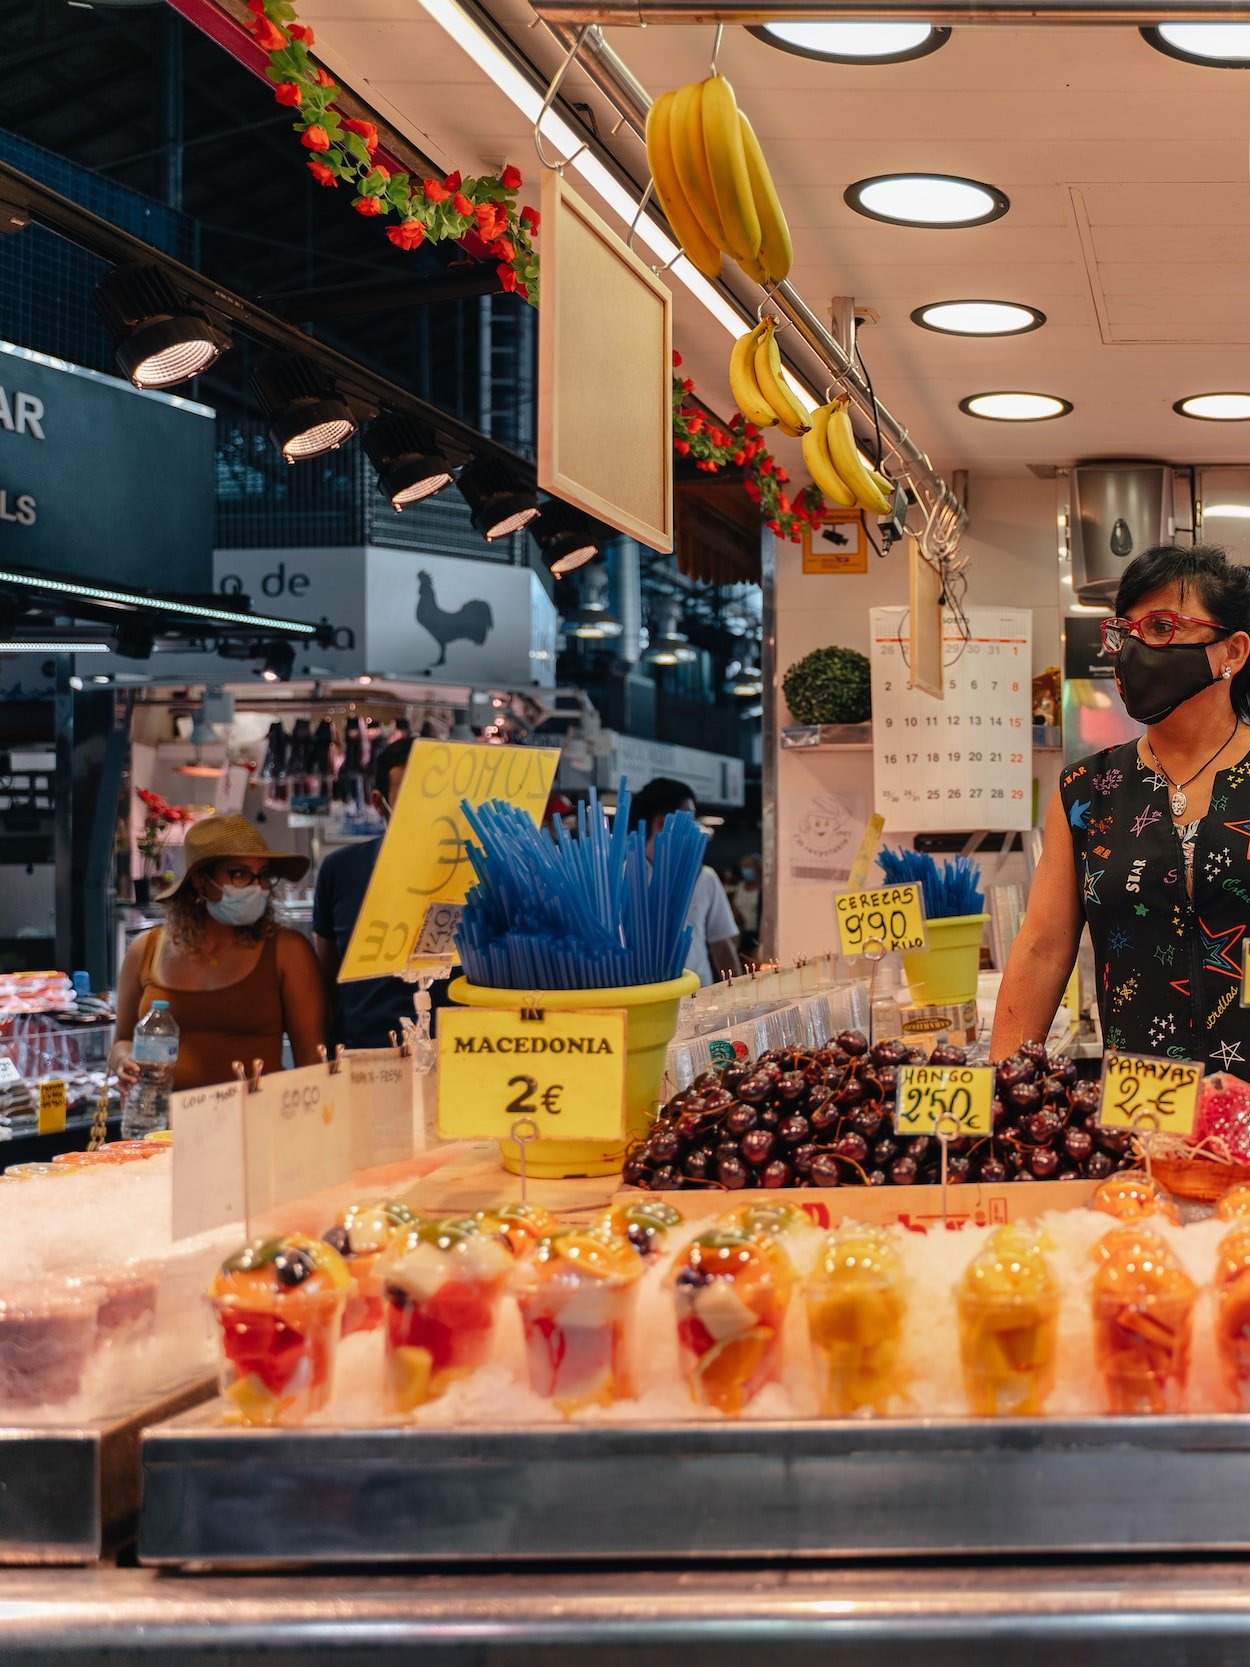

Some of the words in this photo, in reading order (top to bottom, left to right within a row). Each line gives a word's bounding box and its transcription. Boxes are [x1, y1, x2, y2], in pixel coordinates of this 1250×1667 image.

[262, 562, 311, 598] de
[988, 645, 1000, 655] 31
[1013, 646, 1018, 655] 1
[885, 682, 892, 691] 2
[950, 680, 956, 689] 5
[971, 680, 978, 689] 6
[992, 681, 998, 690] 7
[1012, 682, 1019, 691] 8
[886, 718, 893, 728] 9
[904, 717, 918, 727] 10
[926, 716, 938, 726] 11
[947, 716, 960, 725] 12
[969, 716, 982, 725] 13
[990, 717, 1002, 726] 14
[1009, 718, 1021, 727] 15
[884, 755, 897, 764] 16
[906, 754, 918, 763] 17
[927, 753, 939, 762] 18
[948, 752, 961, 761] 19
[969, 752, 982, 761] 20
[990, 752, 1002, 762] 21
[1010, 754, 1023, 763] 22
[1064, 766, 1087, 788] TAR
[927, 790, 940, 799] 25
[948, 789, 961, 798] 26
[969, 789, 982, 798] 27
[991, 789, 1003, 798] 28
[1011, 790, 1023, 799] 29
[1125, 860, 1147, 893] STAR
[837, 887, 915, 912] CEREZAS
[845, 910, 907, 945] 9'90
[890, 937, 924, 952] KILO
[454, 1036, 614, 1055] MACEDONIA
[1107, 1056, 1197, 1088] PAPAYAS
